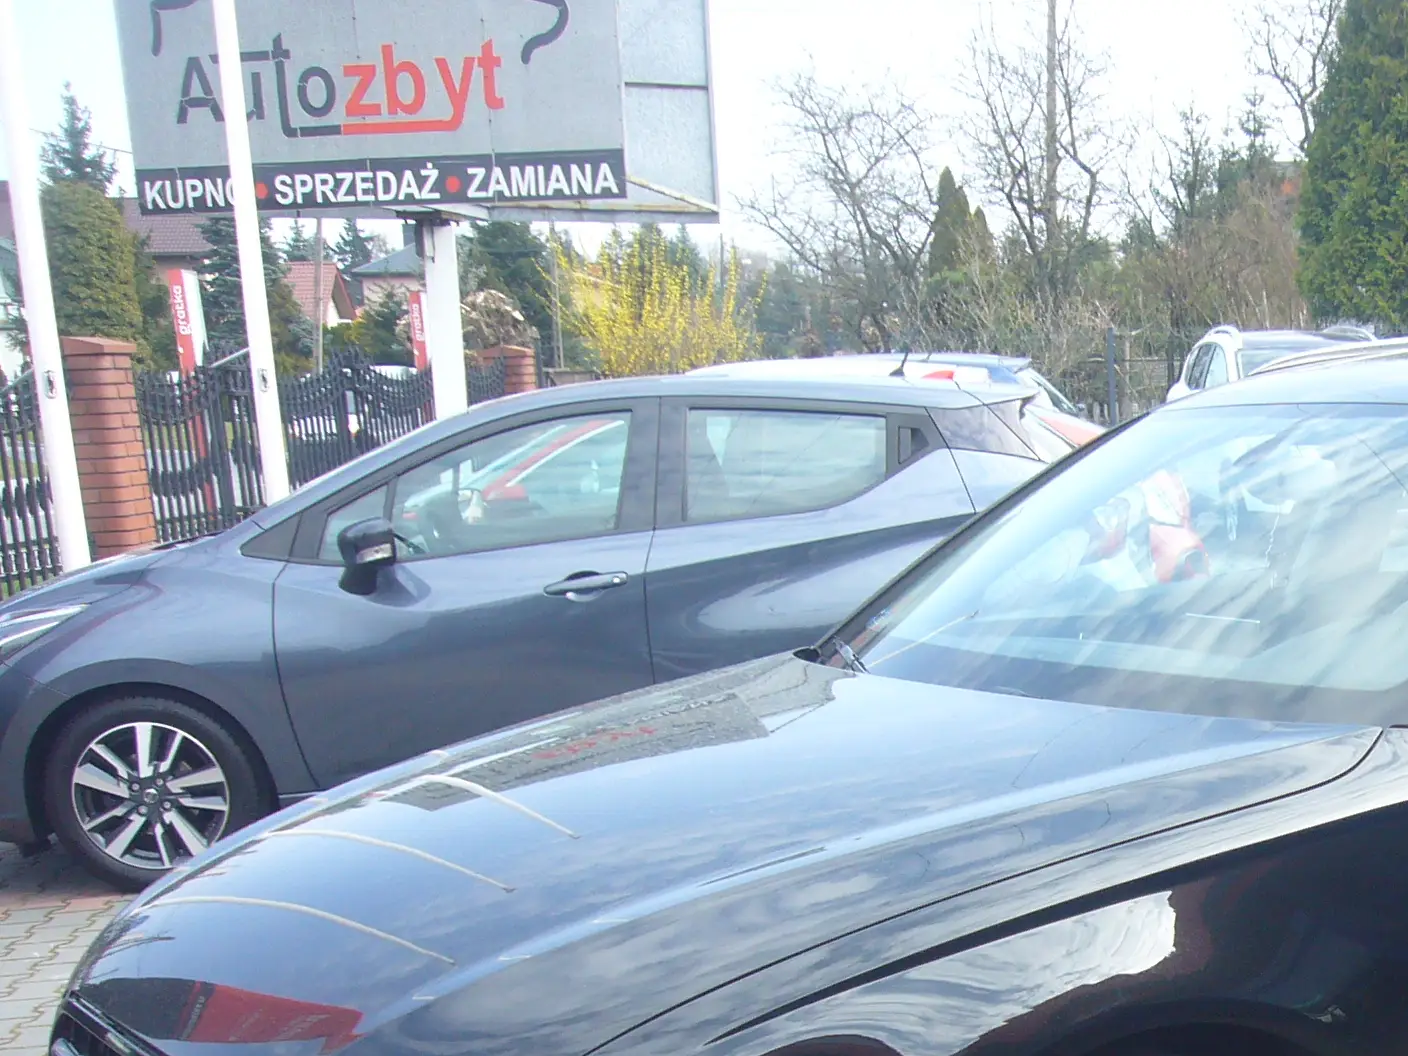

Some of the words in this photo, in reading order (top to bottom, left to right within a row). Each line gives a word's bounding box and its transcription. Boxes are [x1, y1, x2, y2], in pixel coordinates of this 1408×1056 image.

[274, 162, 441, 206] SPRZEDAŻ
[466, 163, 620, 199] ZAMIANA
[172, 284, 192, 336] gratka
